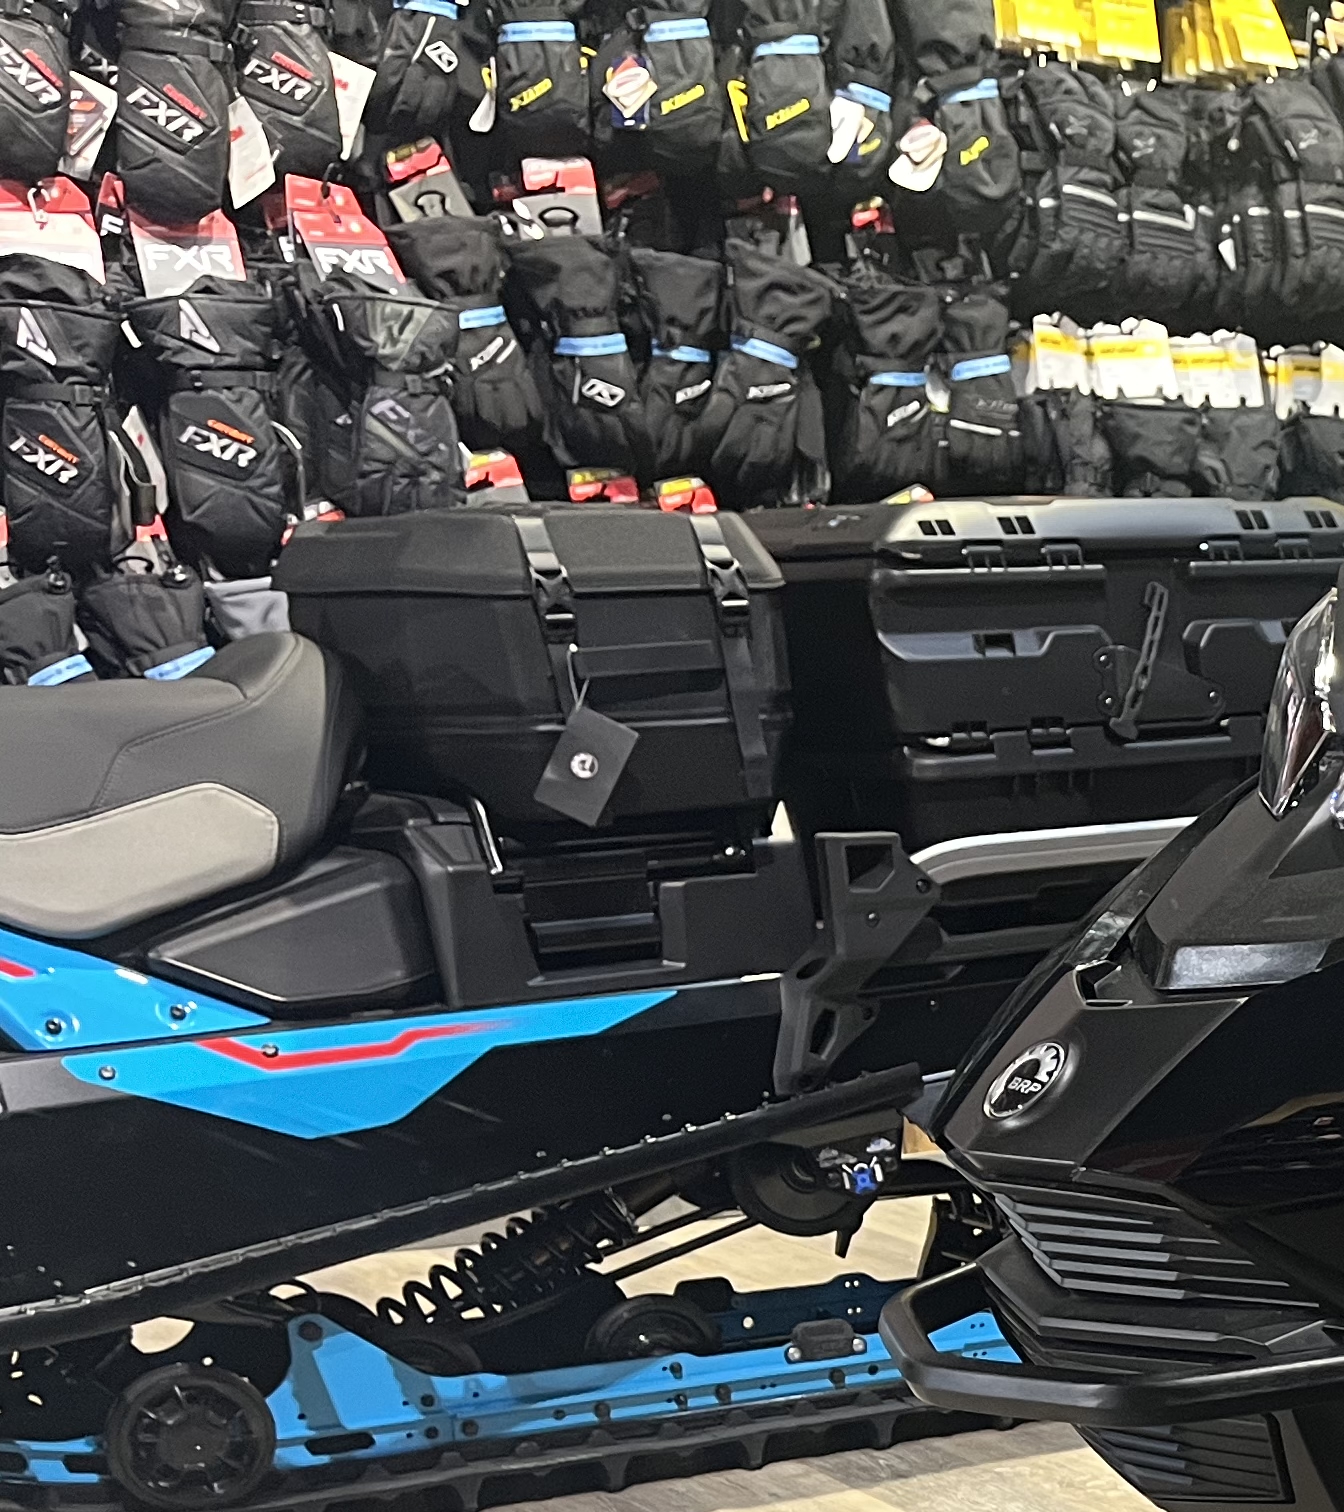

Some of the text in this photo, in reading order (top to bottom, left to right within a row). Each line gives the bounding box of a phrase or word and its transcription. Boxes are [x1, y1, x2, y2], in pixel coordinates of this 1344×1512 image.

[0, 38, 61, 104] FXR
[244, 59, 312, 100] FXR
[126, 85, 204, 142] FXR
[144, 243, 234, 272] FXR
[313, 246, 394, 275] FXR
[9, 435, 78, 484] FXR
[179, 425, 257, 468] FXR
[1007, 1076, 1042, 1094] BRP
